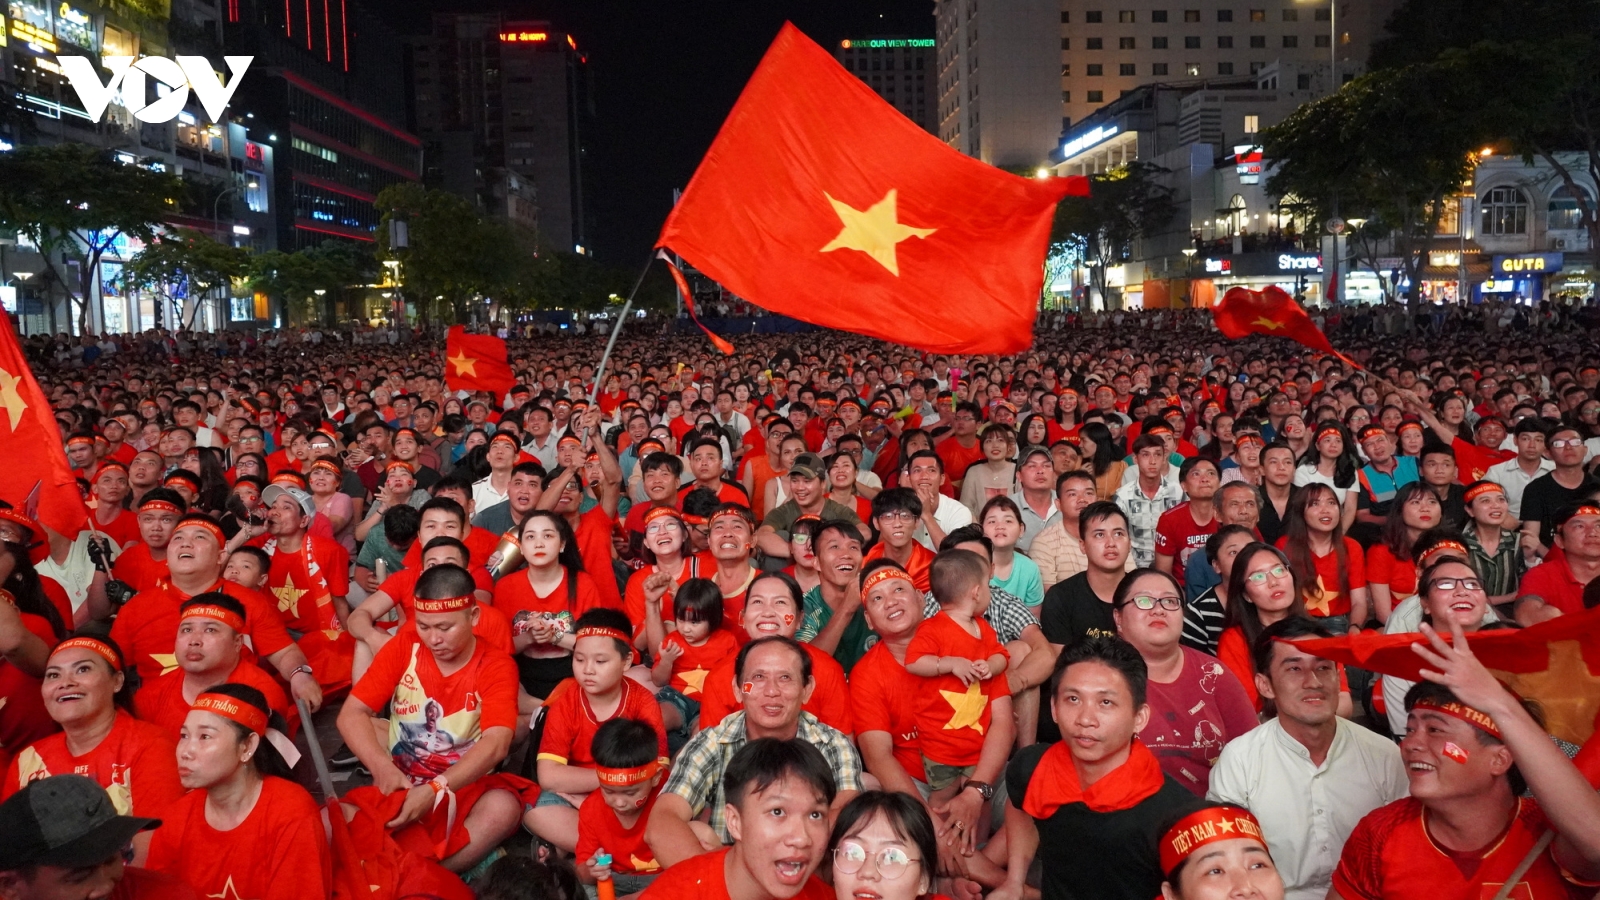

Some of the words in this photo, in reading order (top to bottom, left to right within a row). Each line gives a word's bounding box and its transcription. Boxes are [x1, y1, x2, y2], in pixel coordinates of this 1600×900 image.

[887, 39, 906, 48] VIEW
[908, 39, 935, 47] TOWER
[1502, 258, 1545, 272] GUTA
[1172, 829, 1192, 855] VIỆT
[1190, 820, 1217, 843] NAM
